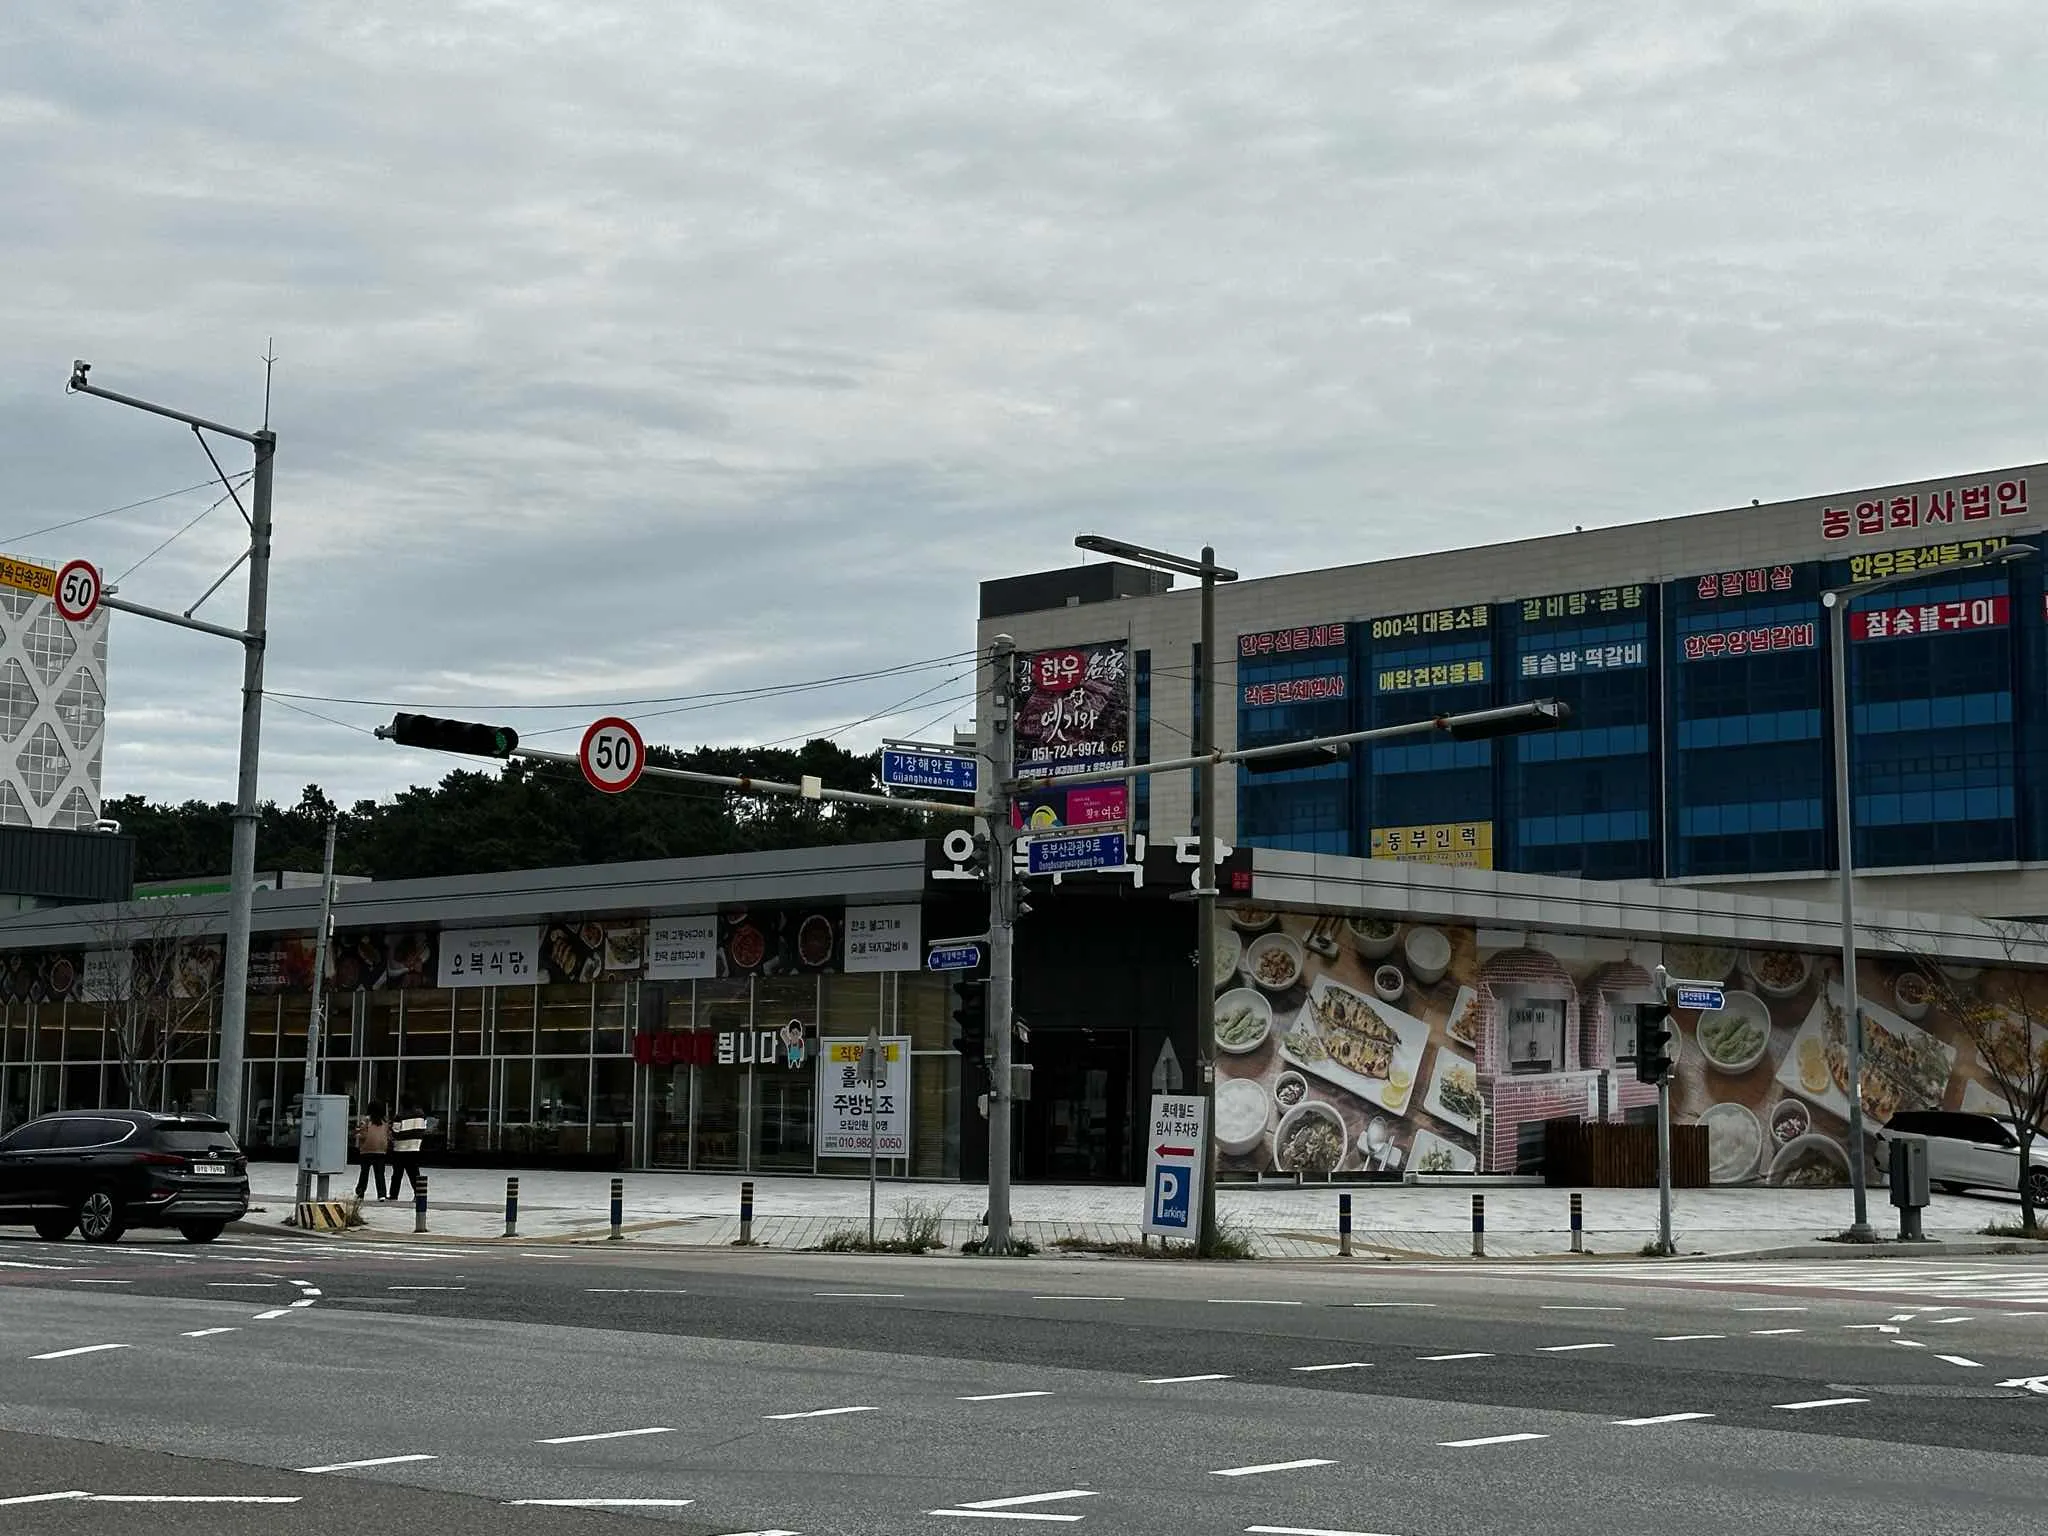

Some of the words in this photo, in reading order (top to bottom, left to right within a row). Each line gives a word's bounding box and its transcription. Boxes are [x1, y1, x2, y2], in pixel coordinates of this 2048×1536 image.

[1821, 479, 2030, 540] 농업회사법인
[63, 574, 92, 607] 50
[1697, 565, 1794, 599] 생갈비살
[1371, 614, 1419, 639] 800석
[1422, 605, 1489, 633] 대중소룸
[1865, 599, 1994, 638] 참숯불구이
[1240, 624, 1346, 657] 한우선물세트
[1684, 623, 1814, 660] 한우양념갈비
[1019, 659, 1032, 693] 기장
[1040, 654, 1080, 686] 한우
[1379, 660, 1485, 691] 애완견전용룸
[1244, 675, 1345, 706] 각종단체행사
[596, 735, 631, 771] 50
[893, 755, 955, 774] 기장해안로
[1032, 741, 1105, 761] 051-724-9974
[1111, 740, 1126, 754] 6F
[892, 771, 955, 787] Gijanghaean-ro
[1101, 805, 1122, 820] 여은
[1041, 838, 1103, 861] 동부산관광9로
[1387, 827, 1476, 851] 동부인력
[869, 919, 893, 931] 불고기
[451, 951, 524, 975] 오복식당
[718, 1031, 777, 1064] 됩니다
[833, 1094, 895, 1116] 주방보조
[1161, 1103, 1195, 1118] 롯데월드
[839, 1119, 869, 1131] 모집인원
[1155, 1121, 1172, 1136] 임시
[1174, 1122, 1199, 1137] 주차장
[1156, 1172, 1187, 1223] Parking
